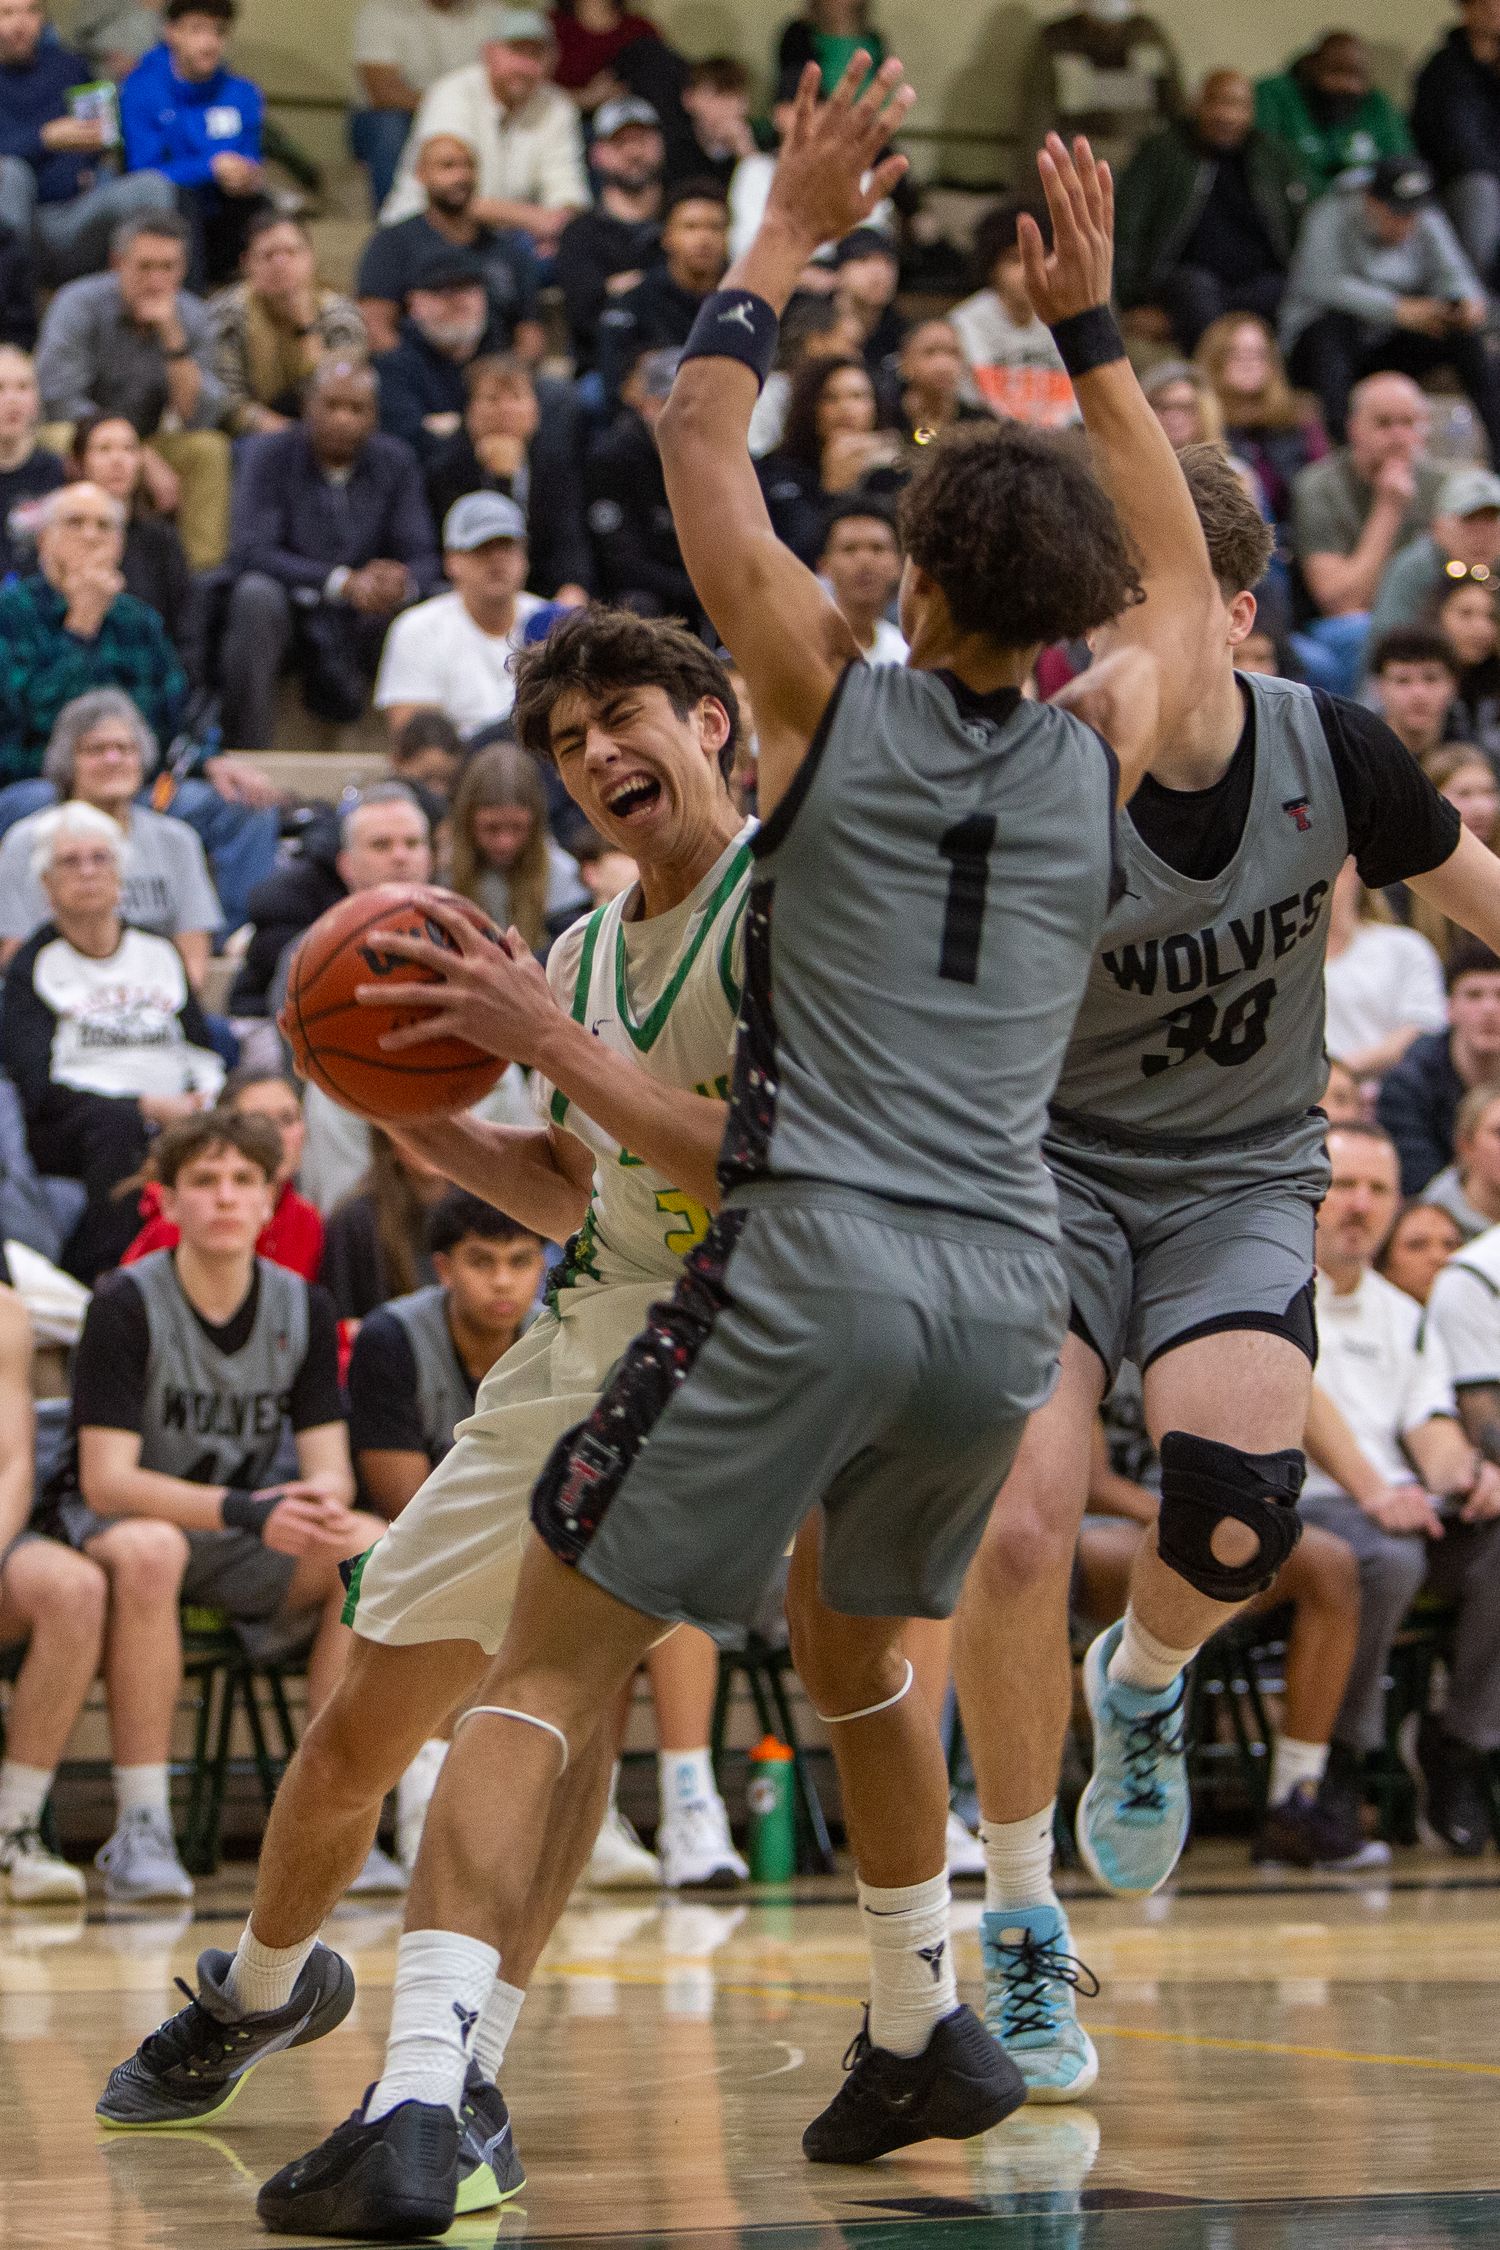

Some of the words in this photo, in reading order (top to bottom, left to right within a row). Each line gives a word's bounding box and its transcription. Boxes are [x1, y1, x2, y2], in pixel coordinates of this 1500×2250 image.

[938, 812, 997, 985] 1
[1101, 879, 1329, 996] WOLVES
[1140, 977, 1278, 1078] 30
